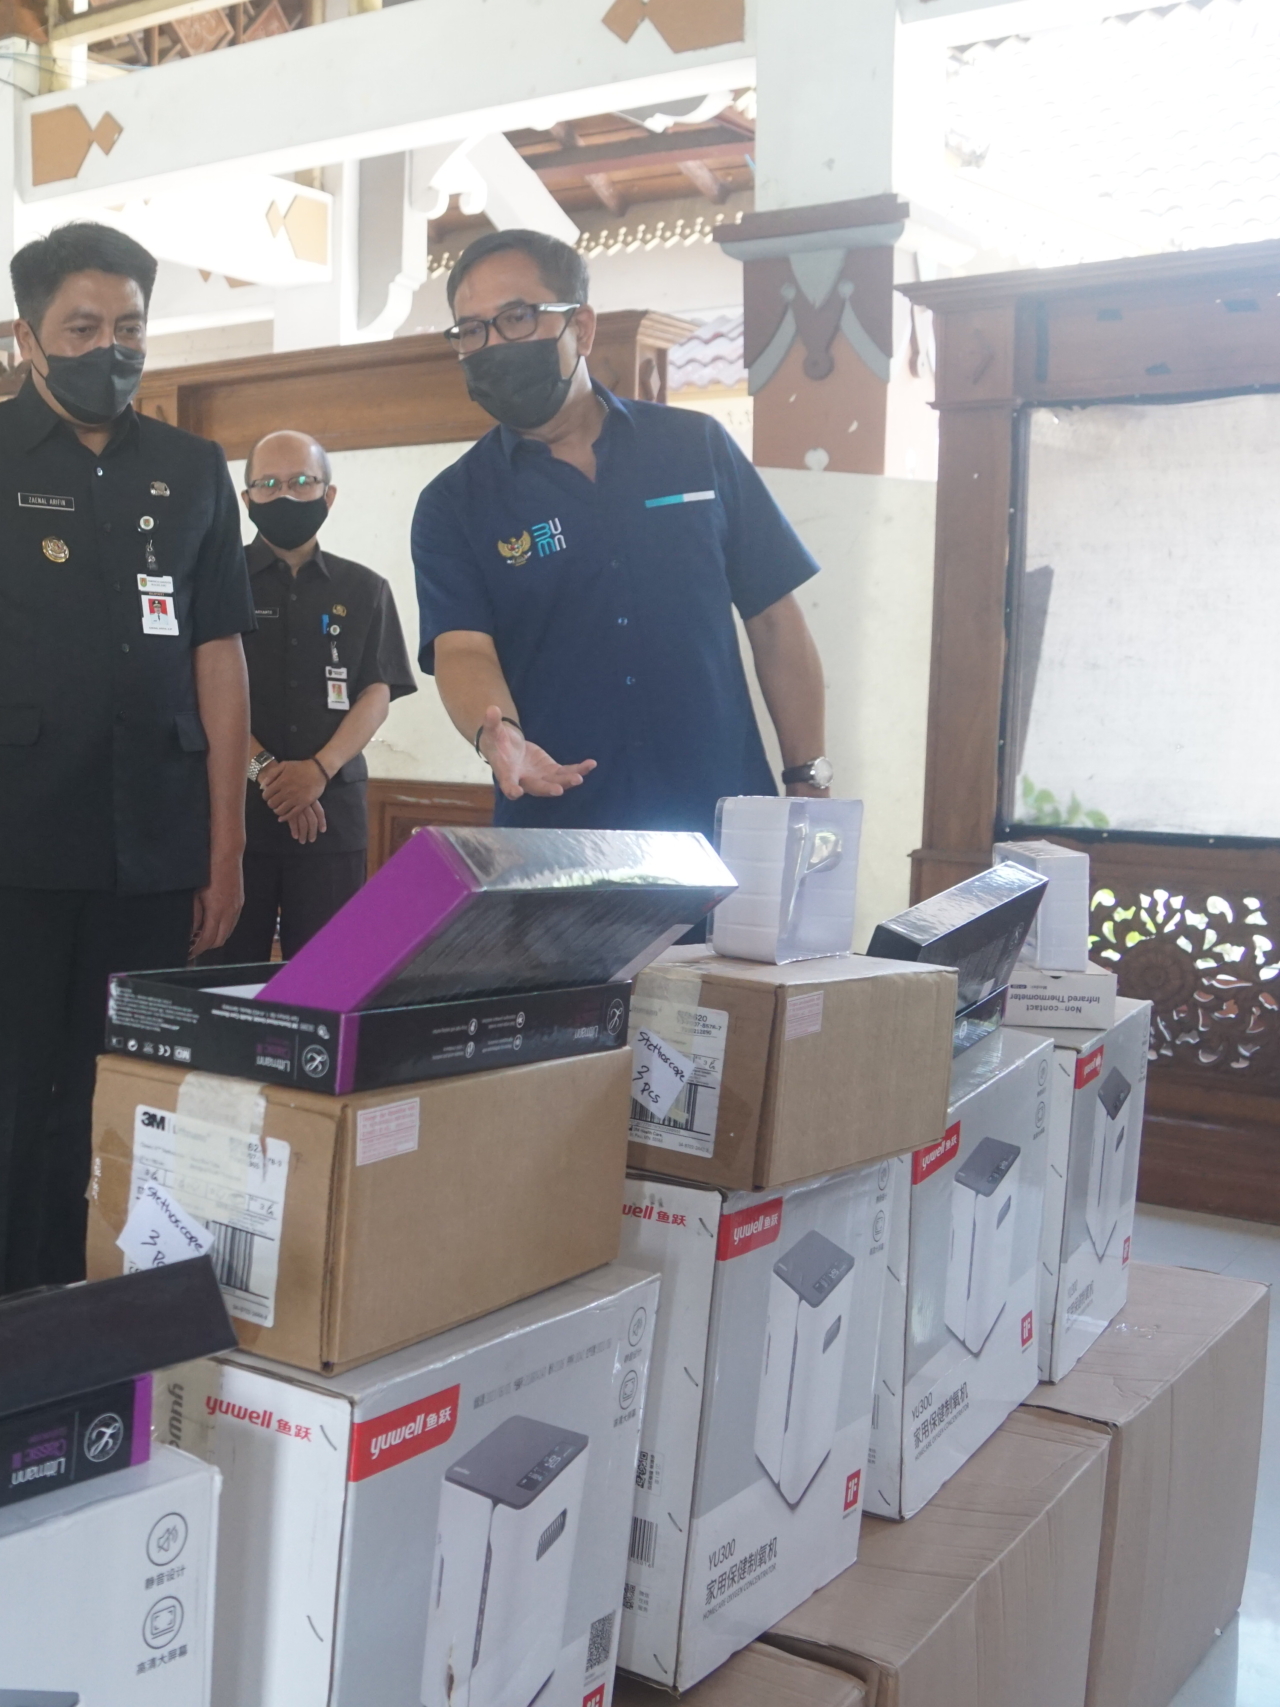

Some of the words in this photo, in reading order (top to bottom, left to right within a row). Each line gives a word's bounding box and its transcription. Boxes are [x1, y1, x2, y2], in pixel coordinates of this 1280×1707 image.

[1009, 993, 1066, 1003] Thermometer
[1026, 1004, 1082, 1013] Non-contact
[1067, 995, 1100, 1004] Infrared
[256, 1055, 291, 1073] Littmann
[637, 1031, 685, 1083] Stethoscope
[141, 1111, 166, 1132] 3M
[921, 1139, 946, 1171] yuwell
[145, 1186, 204, 1254] Stethoscope
[655, 1210, 687, 1228] 鱼跃
[733, 1214, 763, 1245] yuwell
[763, 1212, 779, 1230] 鱼跃
[140, 1229, 160, 1247] 3
[205, 1395, 273, 1430] yuwell
[424, 1406, 453, 1433] 鱼跃
[911, 1391, 933, 1422] YU300
[274, 1417, 313, 1443] 鱼跃
[370, 1413, 426, 1460] yuwell
[11, 1458, 66, 1486] Littmann
[708, 1538, 736, 1571] YU300
[144, 1565, 187, 1591] 静音设计
[704, 1536, 778, 1606] 家用保健制氧机
[702, 1597, 726, 1622] HOMECARE
[726, 1585, 743, 1607] OXYGEN
[743, 1562, 777, 1594] CONCENTRATOR
[136, 1644, 189, 1677] 高清大屏幕
